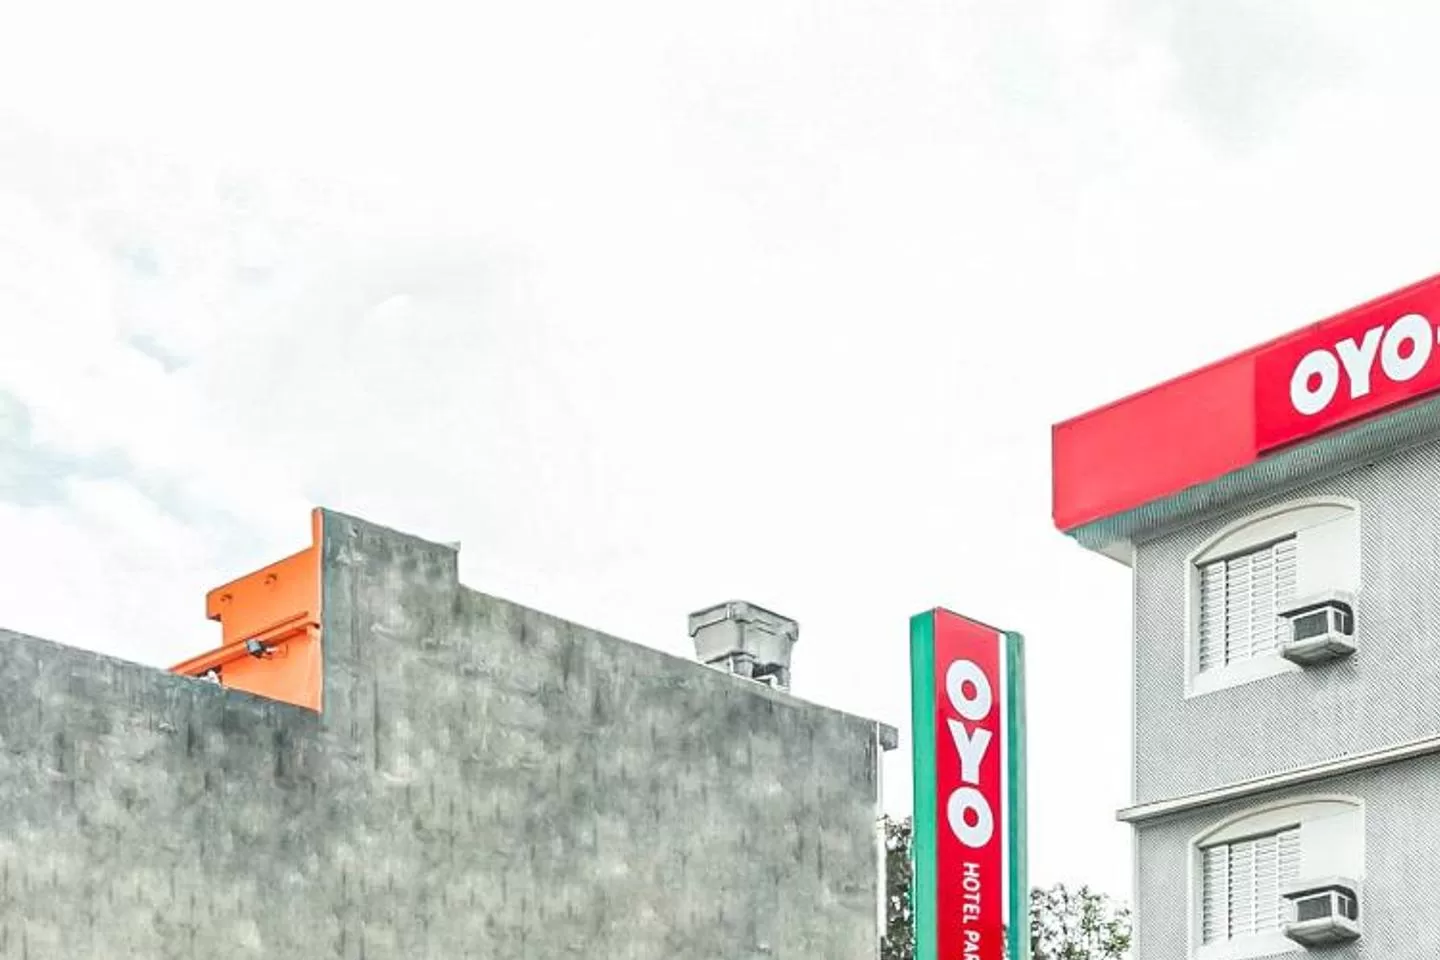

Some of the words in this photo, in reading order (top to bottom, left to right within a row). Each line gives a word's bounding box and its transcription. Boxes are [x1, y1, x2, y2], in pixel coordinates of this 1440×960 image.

[1289, 313, 1434, 416] OYO
[945, 658, 995, 849] OYO
[962, 861, 981, 924] HOTEL
